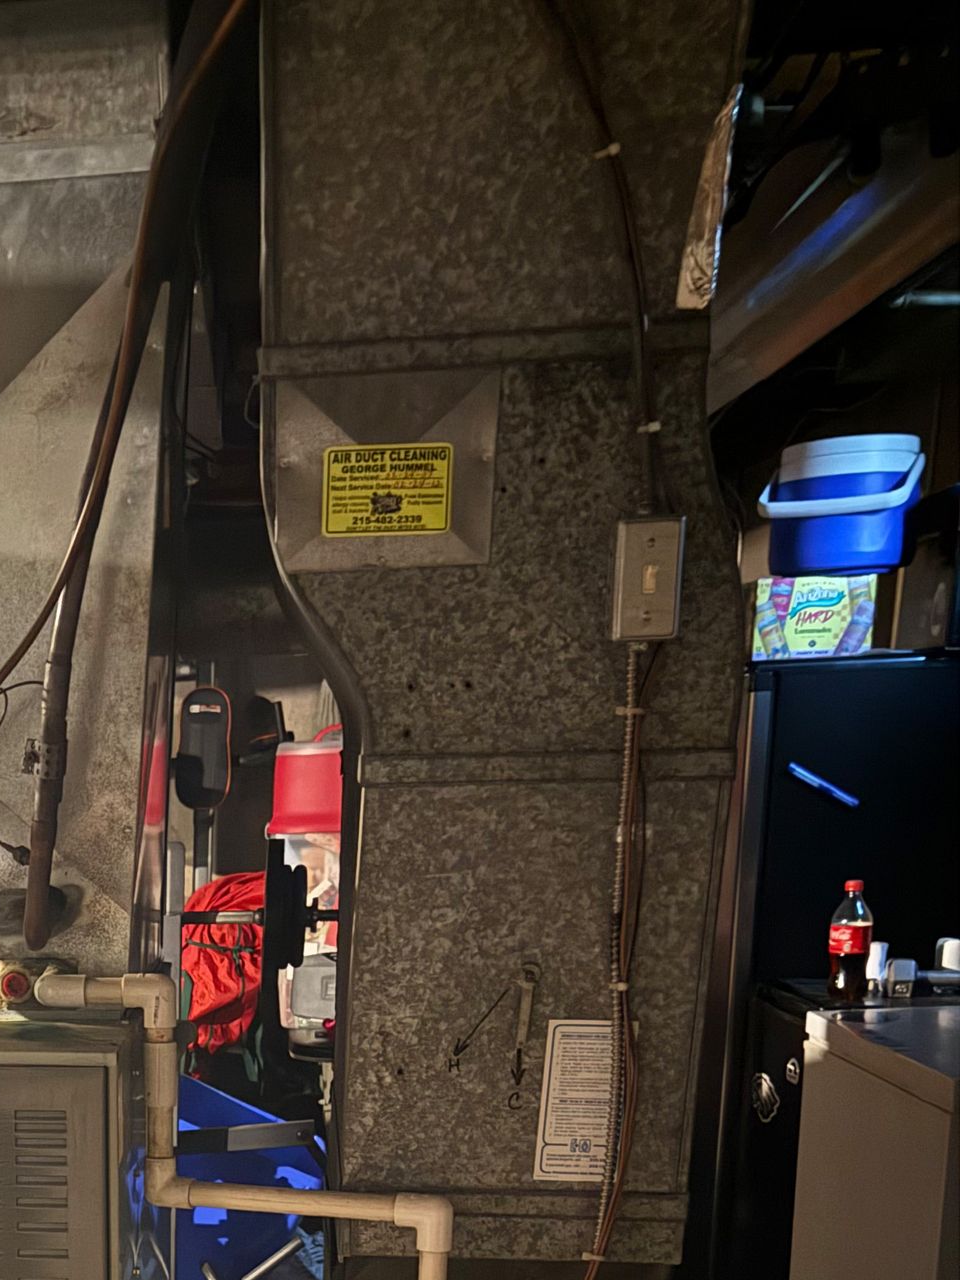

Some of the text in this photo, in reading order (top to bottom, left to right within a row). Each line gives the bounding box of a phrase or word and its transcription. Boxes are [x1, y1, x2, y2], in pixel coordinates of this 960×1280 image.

[332, 450, 447, 464] AIR DUCT CLEANING
[342, 463, 437, 474] GEORGE HUMMEL
[352, 515, 422, 525] 215-482-2339
[795, 610, 834, 627] HARD
